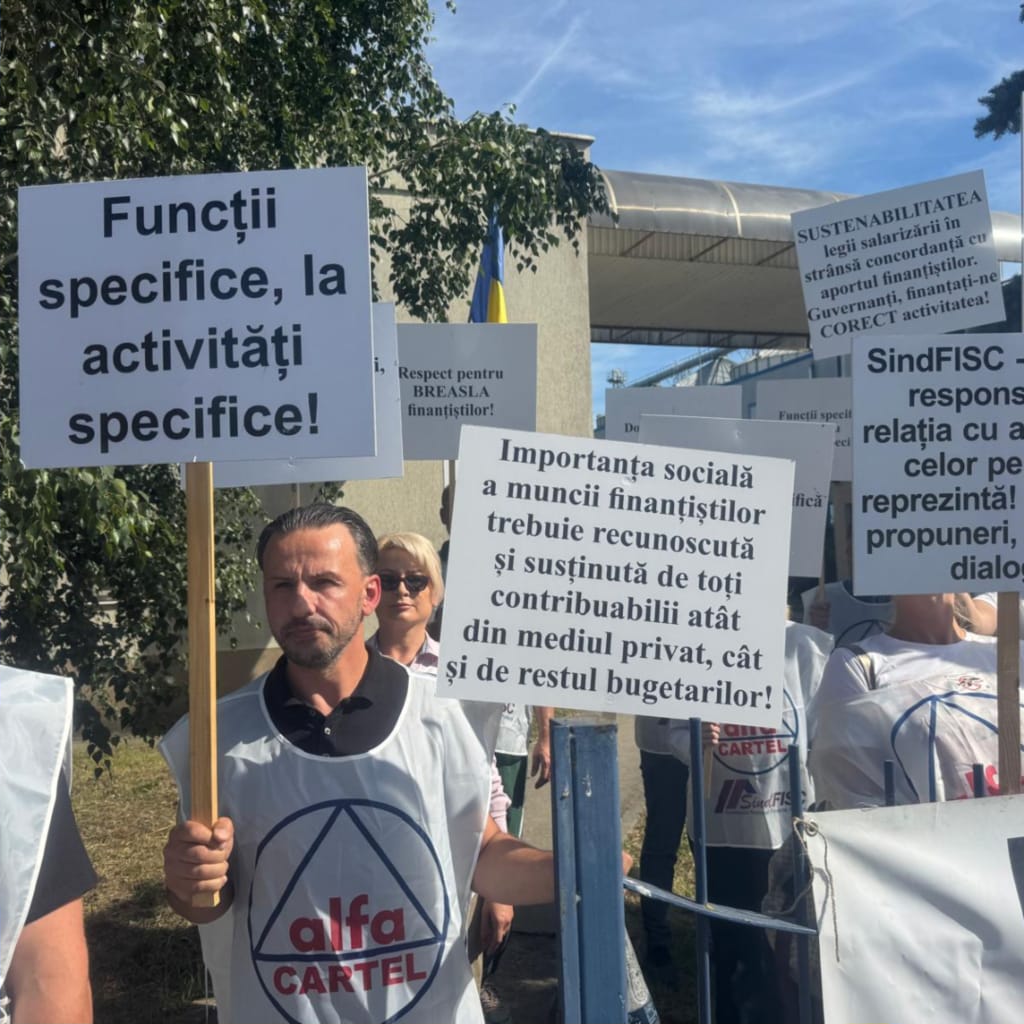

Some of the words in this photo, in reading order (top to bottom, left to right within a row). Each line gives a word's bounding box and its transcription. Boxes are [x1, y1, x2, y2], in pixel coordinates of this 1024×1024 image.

[104, 187, 276, 244] Funcții
[40, 259, 282, 318] specifice,
[304, 254, 346, 296] la
[83, 324, 302, 381] activități
[399, 366, 452, 382] Respect
[458, 369, 503, 382] pentru
[408, 404, 493, 419] finanțiștilor!
[414, 386, 489, 397] BREASLA
[69, 392, 318, 453] specifice!
[500, 439, 654, 482] Importanța
[664, 462, 753, 488] socială
[483, 480, 496, 496] a
[507, 482, 599, 507] muncii
[609, 487, 766, 524] finanțiștilor
[488, 512, 584, 541] trebuie
[594, 527, 754, 560] recunoscută
[495, 548, 515, 576] și
[524, 556, 647, 584] susținută
[658, 565, 688, 588] de
[698, 570, 741, 600] toți
[491, 590, 678, 624] contribuabilii
[688, 606, 740, 631] atât
[464, 619, 506, 644] din
[518, 628, 612, 655] mediul
[622, 637, 712, 670] privat,
[722, 645, 762, 670] cât
[446, 655, 467, 685] și
[477, 658, 508, 682] de
[519, 667, 596, 691] restul
[608, 669, 772, 709] bugetarilor!
[289, 894, 405, 953] alfa
[273, 953, 427, 996] CARTEL
